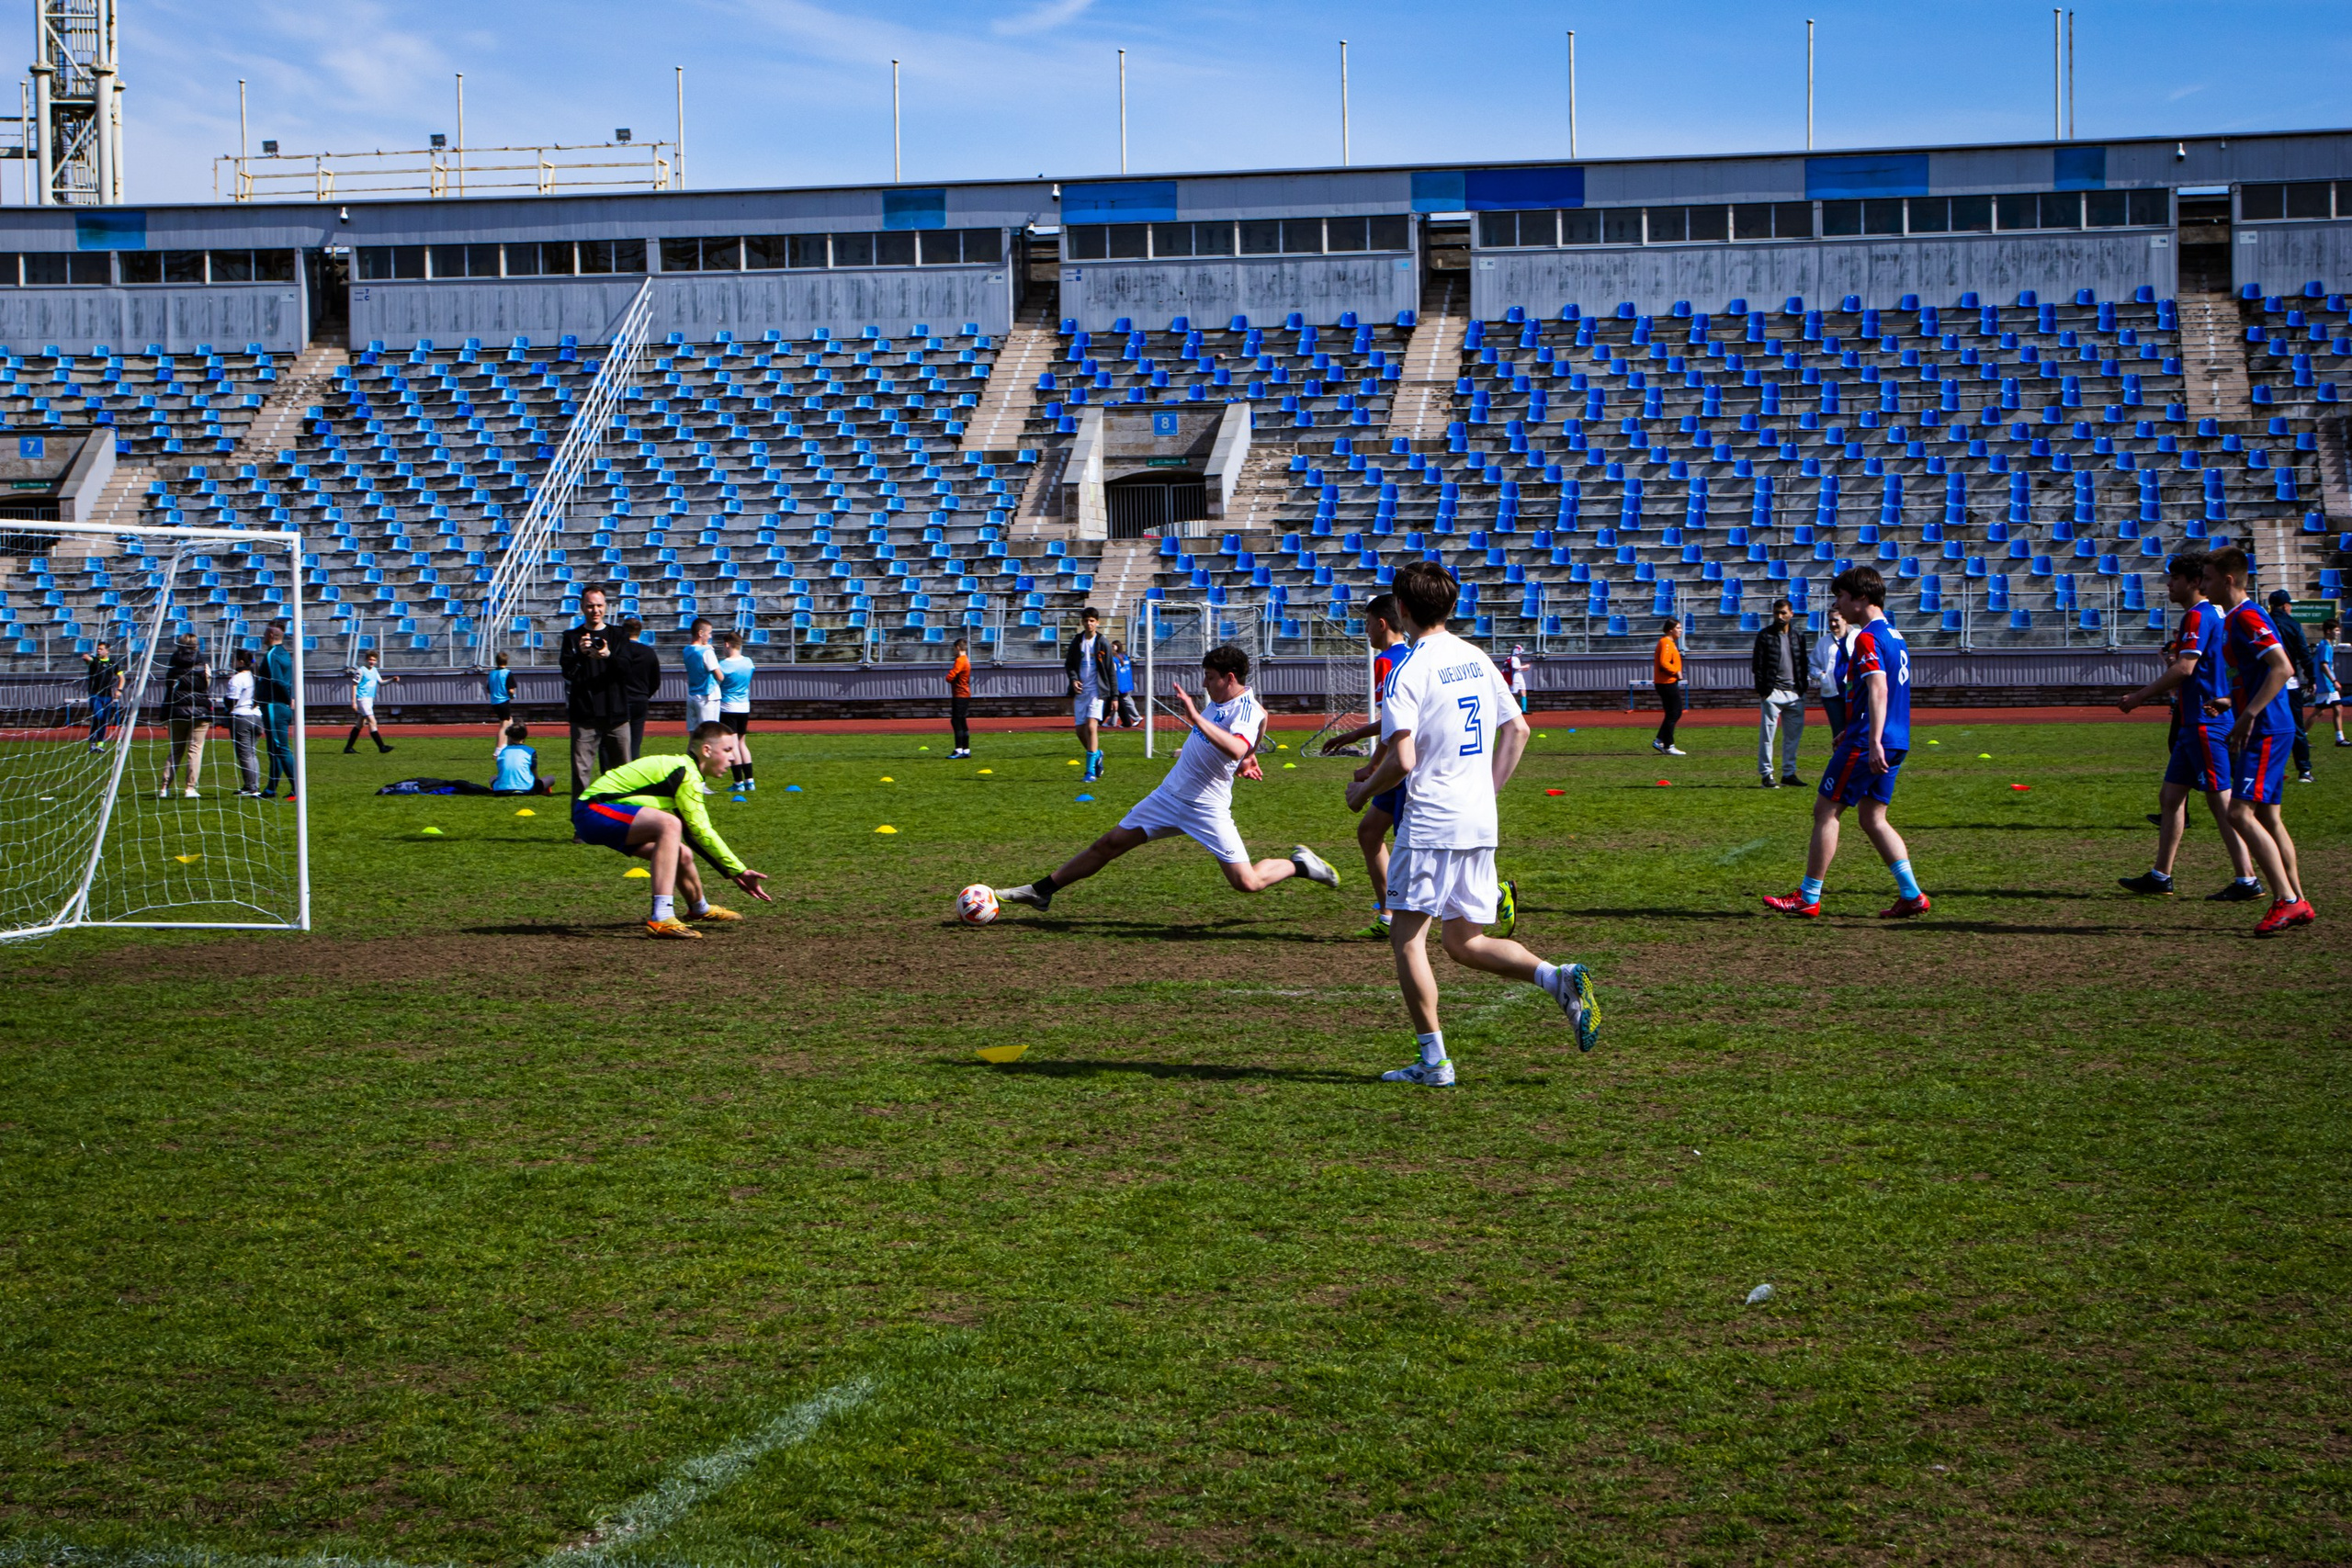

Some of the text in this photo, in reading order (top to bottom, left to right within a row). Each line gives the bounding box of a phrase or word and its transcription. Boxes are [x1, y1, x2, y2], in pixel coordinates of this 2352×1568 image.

[1160, 417, 1170, 429] 8
[27, 441, 36, 452] 7
[1897, 649, 1909, 686] 8
[1457, 695, 1483, 756] 3
[1824, 777, 1835, 791] 8
[2198, 771, 2206, 784] 4
[2243, 777, 2255, 794] 7
